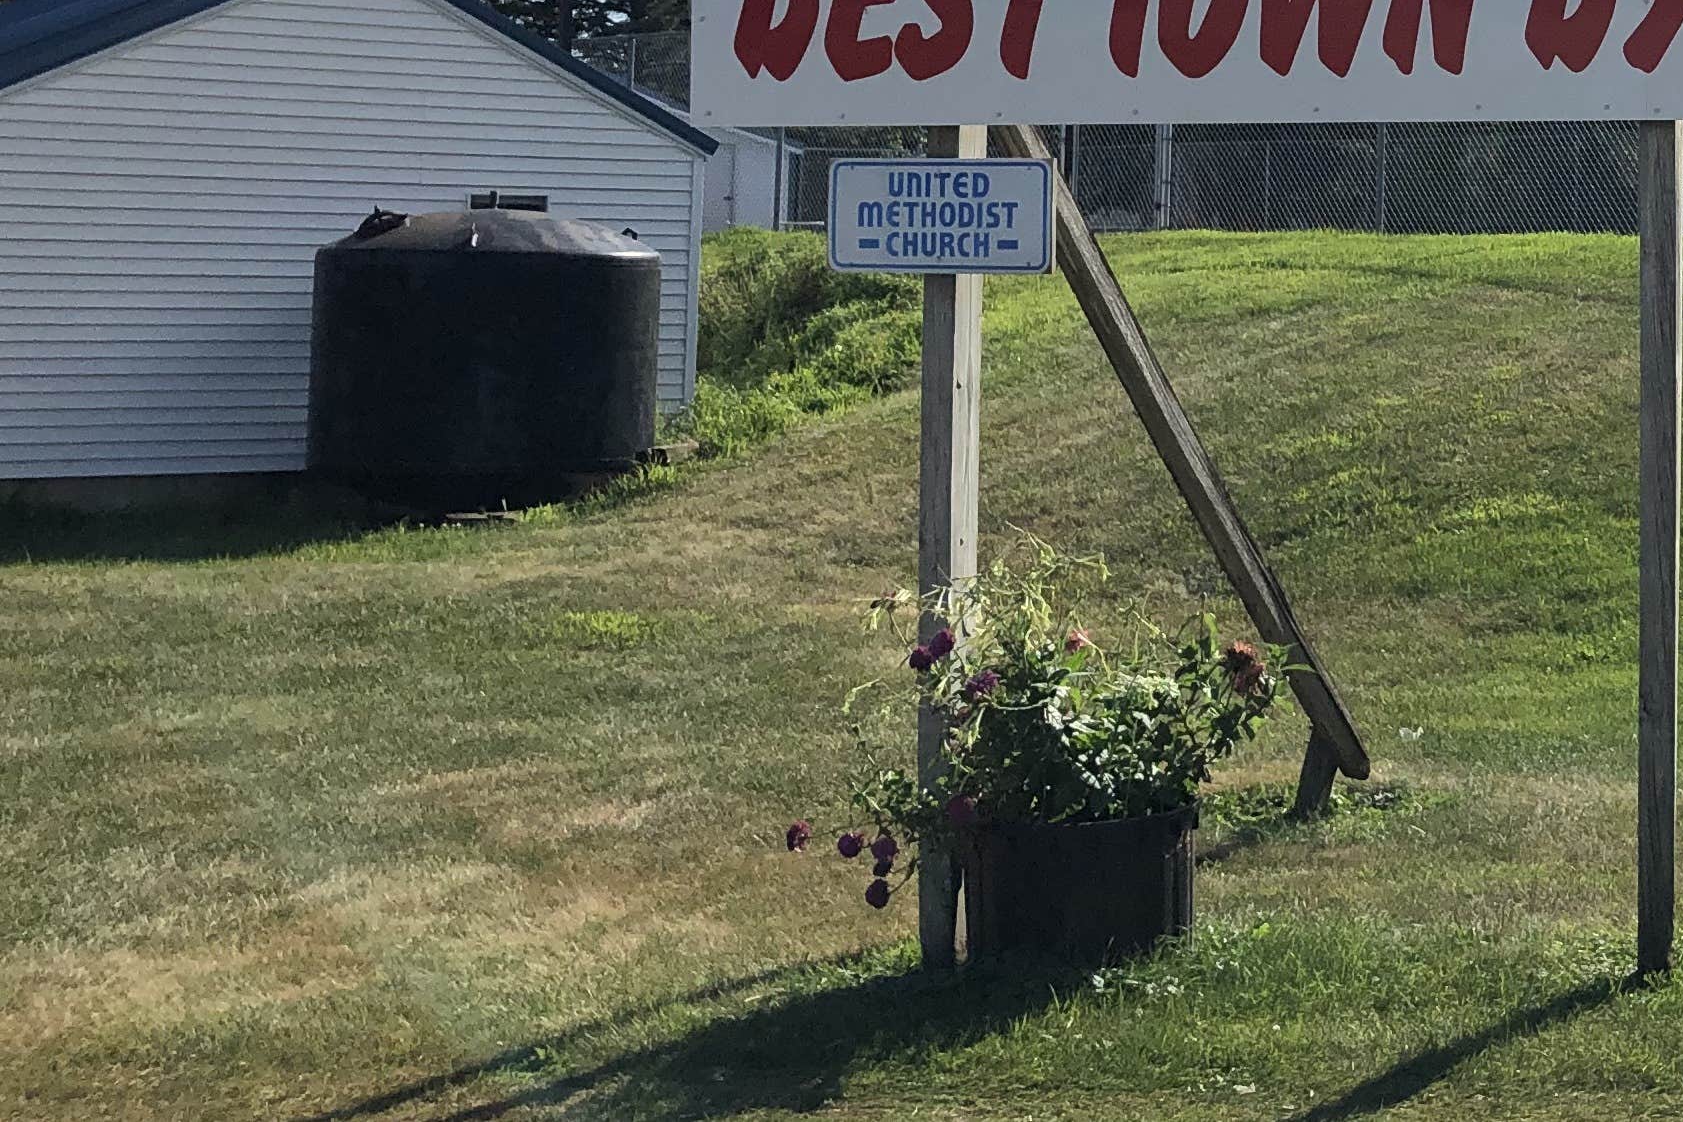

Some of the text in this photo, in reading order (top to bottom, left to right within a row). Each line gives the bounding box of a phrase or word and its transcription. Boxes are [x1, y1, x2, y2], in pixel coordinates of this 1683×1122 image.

[888, 171, 990, 199] UNITED
[857, 200, 1019, 228] METHODIST
[885, 231, 991, 258] CHURCH
